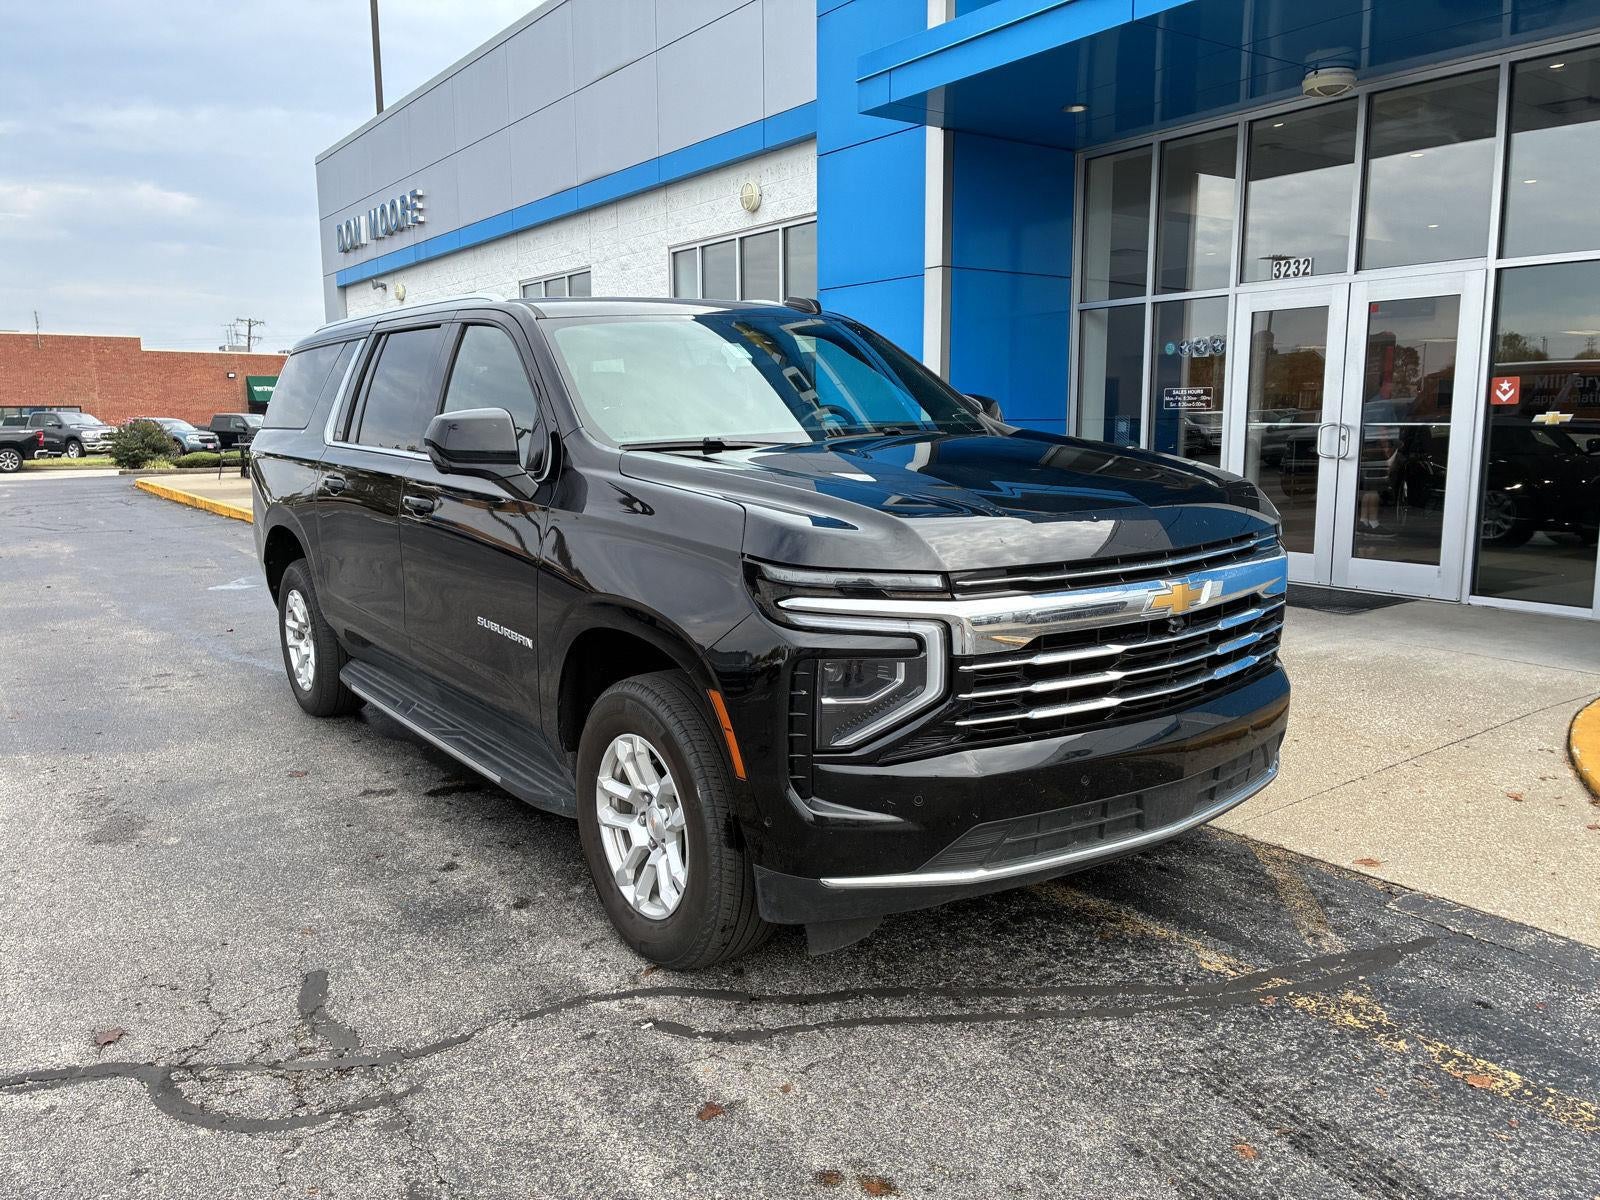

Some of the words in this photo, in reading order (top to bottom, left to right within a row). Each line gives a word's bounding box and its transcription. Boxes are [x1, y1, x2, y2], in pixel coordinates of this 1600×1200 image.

[336, 216, 367, 253] DON
[368, 189, 425, 241] MOORE
[1273, 258, 1311, 279] 3232
[476, 615, 534, 650] SUBURBAN
